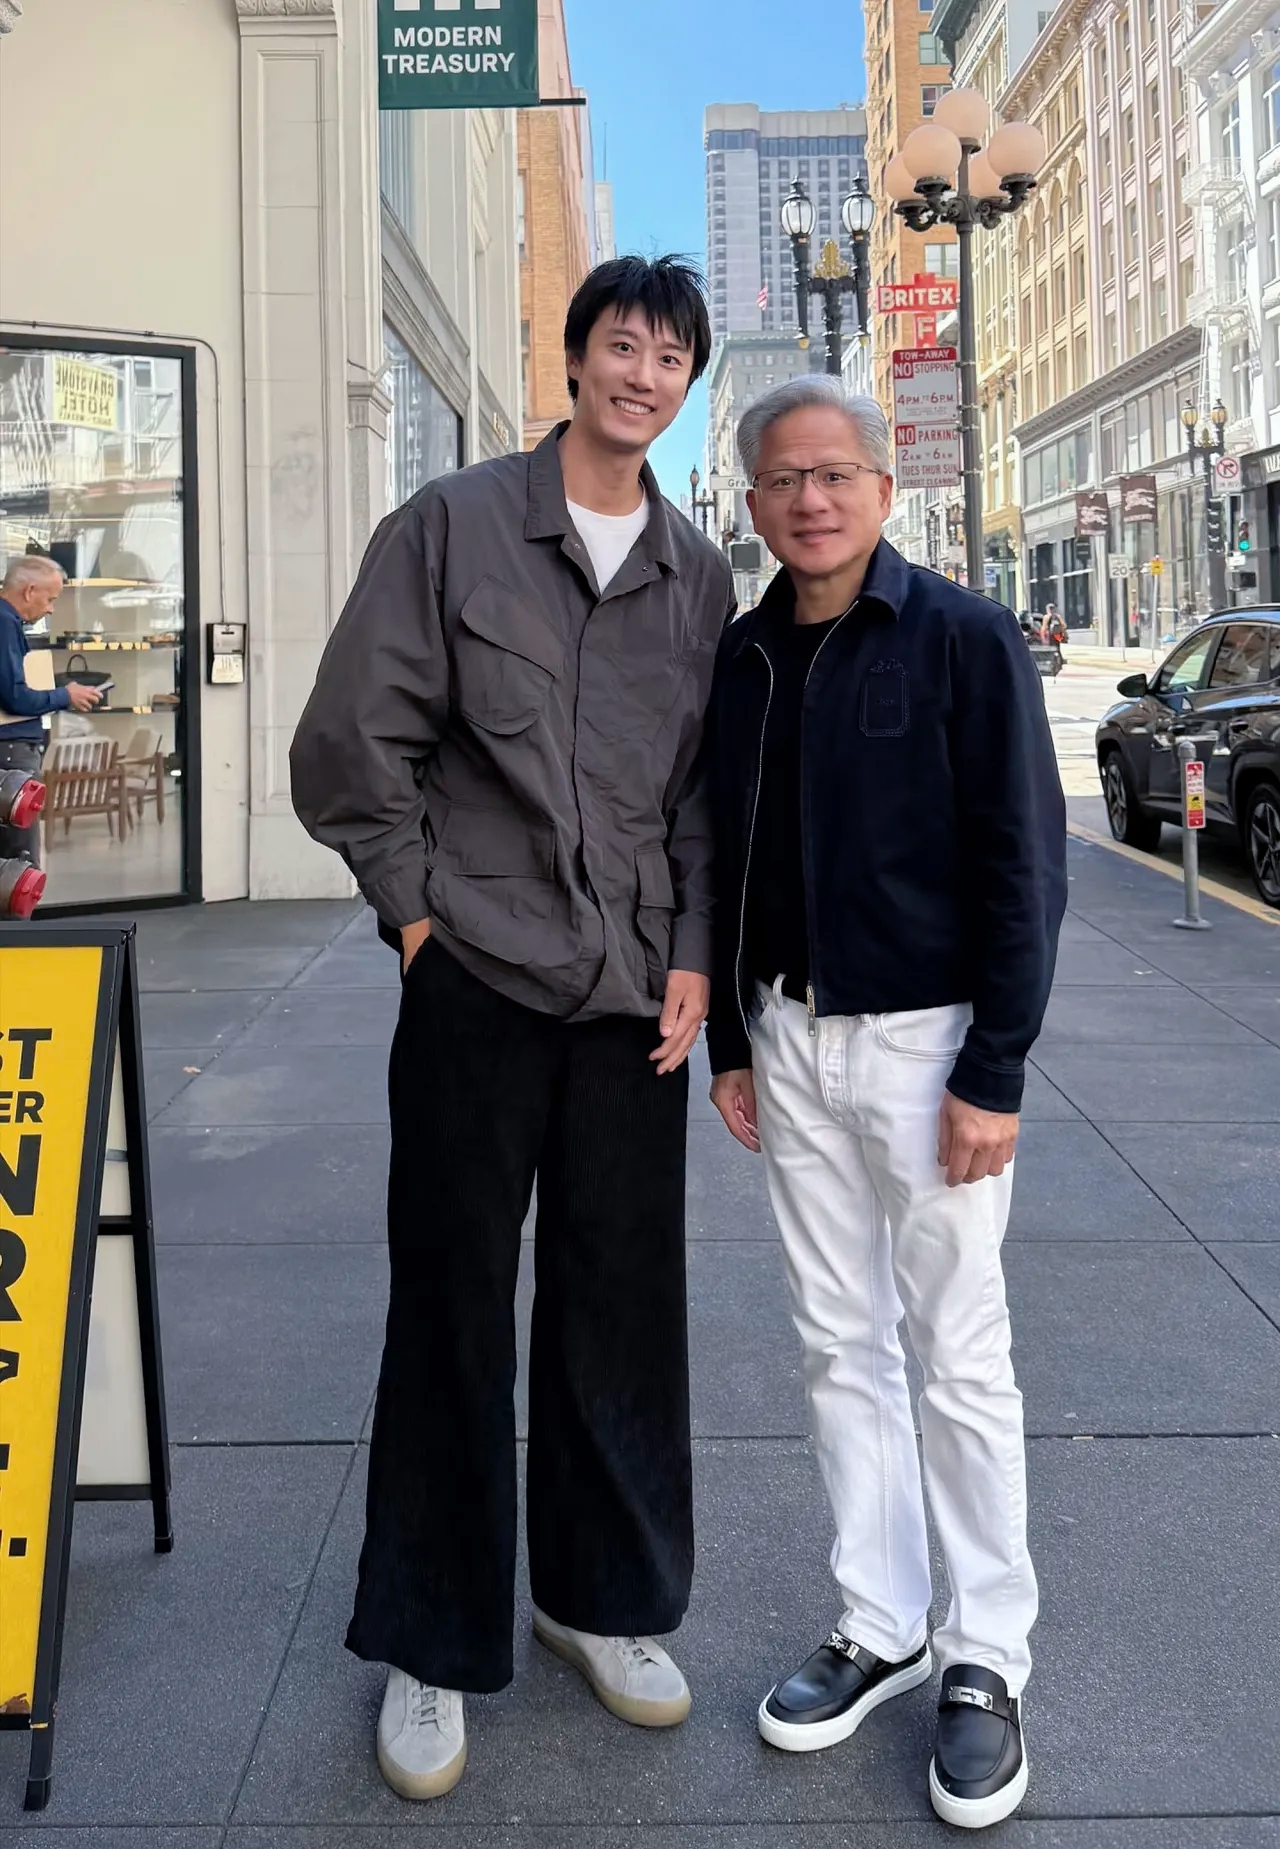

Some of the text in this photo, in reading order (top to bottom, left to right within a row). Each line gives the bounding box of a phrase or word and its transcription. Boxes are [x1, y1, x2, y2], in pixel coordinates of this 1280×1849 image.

[394, 26, 502, 47] MODERN
[382, 53, 515, 74] TREASURY
[880, 287, 954, 310] BRITEX
[899, 349, 950, 361] TOW-AWAY
[894, 362, 955, 377] NO STOPPING
[897, 427, 958, 445] NO PARKING
[727, 479, 747, 487] Gra
[1112, 566, 1127, 576] 20
[0, 1028, 53, 1080] T
